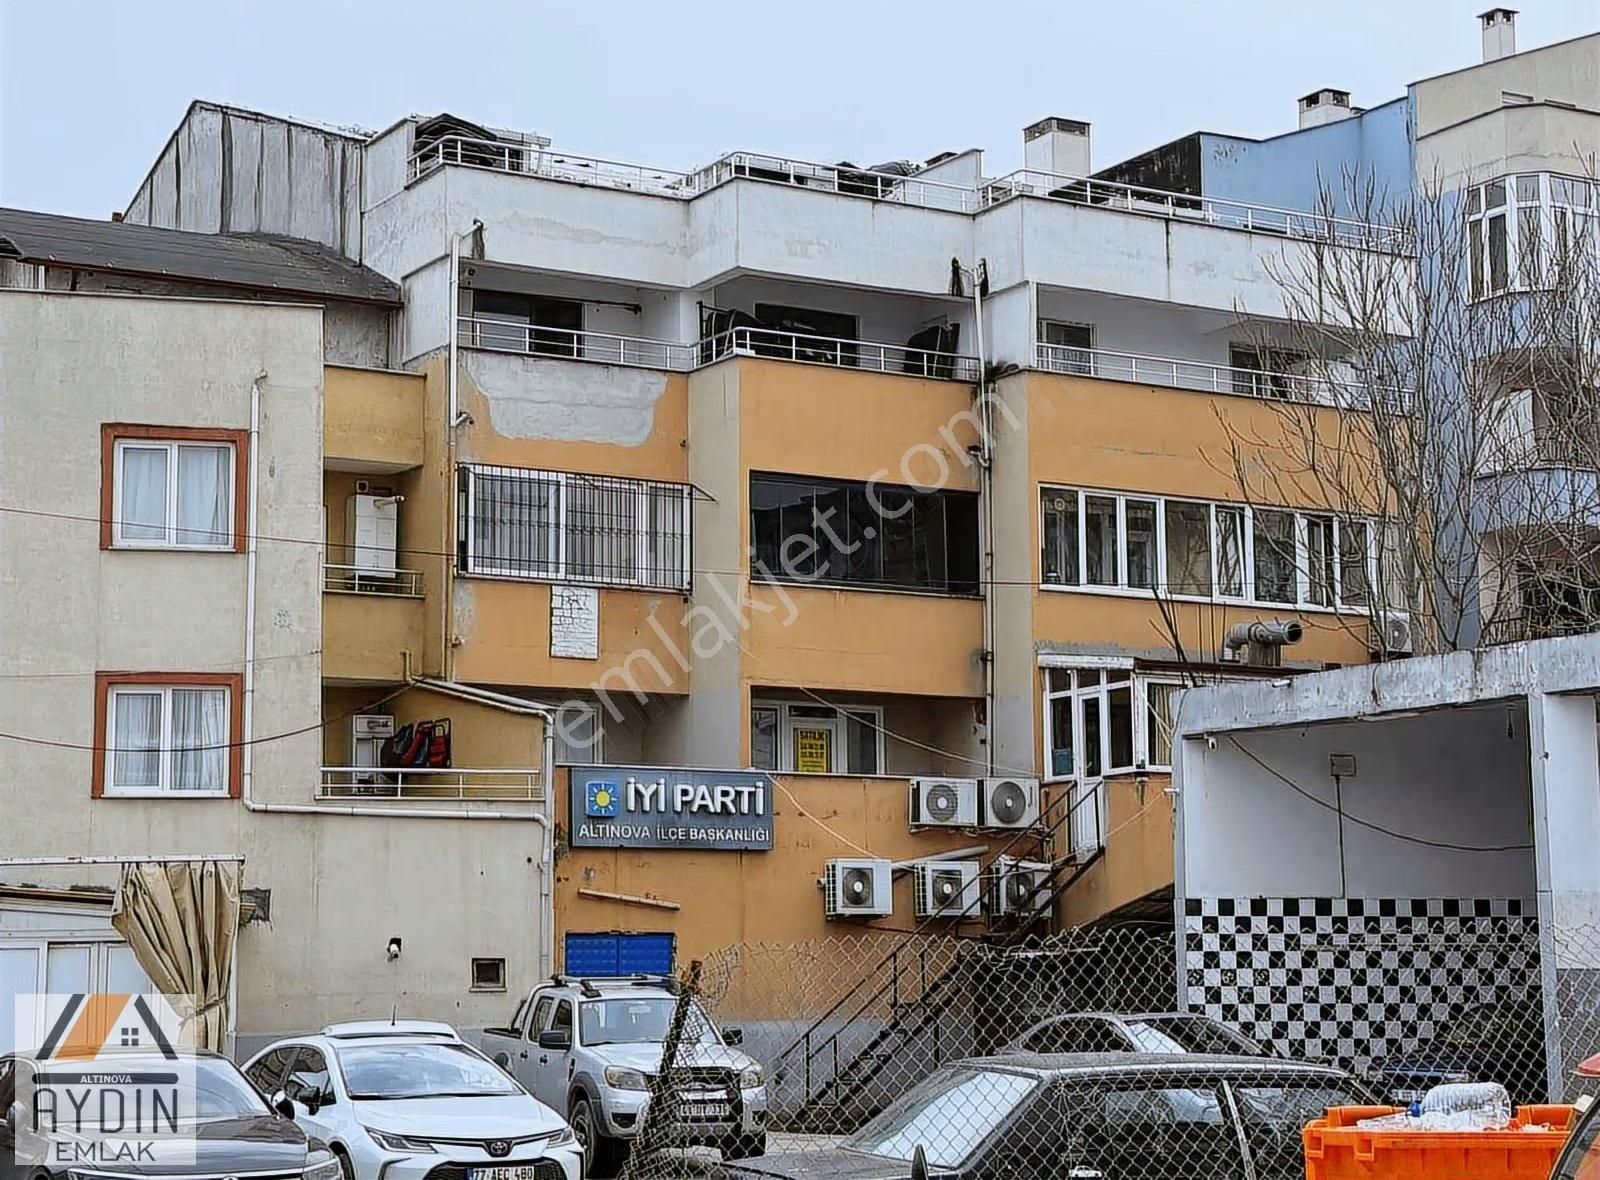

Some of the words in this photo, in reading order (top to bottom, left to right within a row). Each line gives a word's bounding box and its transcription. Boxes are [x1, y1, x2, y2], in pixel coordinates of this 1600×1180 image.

[626, 777, 665, 812] İYİ
[673, 781, 764, 816] PARTİ
[579, 824, 650, 839] ALTINOVA
